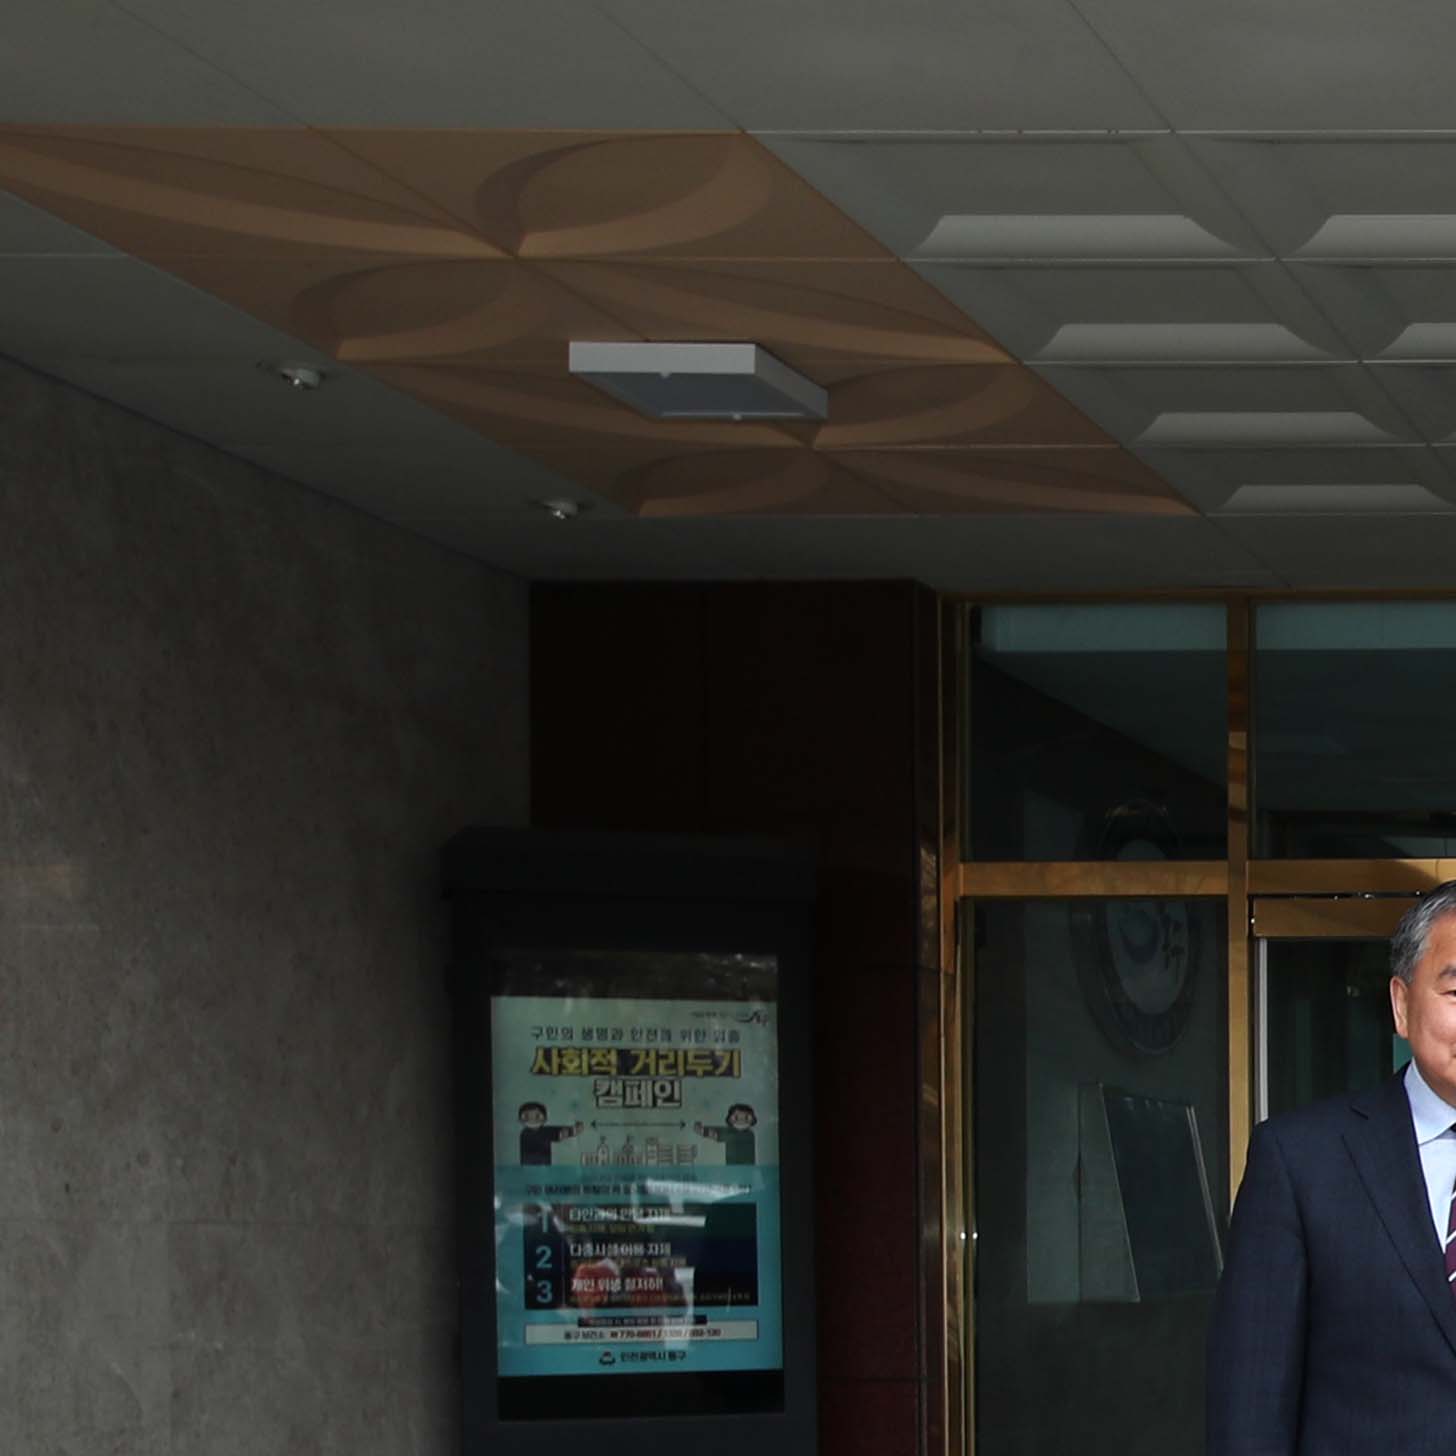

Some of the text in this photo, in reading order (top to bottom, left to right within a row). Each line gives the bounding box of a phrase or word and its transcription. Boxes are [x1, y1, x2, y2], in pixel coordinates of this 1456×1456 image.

[532, 1046, 743, 1077] 사회적 거리두기
[594, 1079, 683, 1108] 캠페인
[536, 1245, 553, 1268] 2
[536, 1281, 553, 1303] 3
